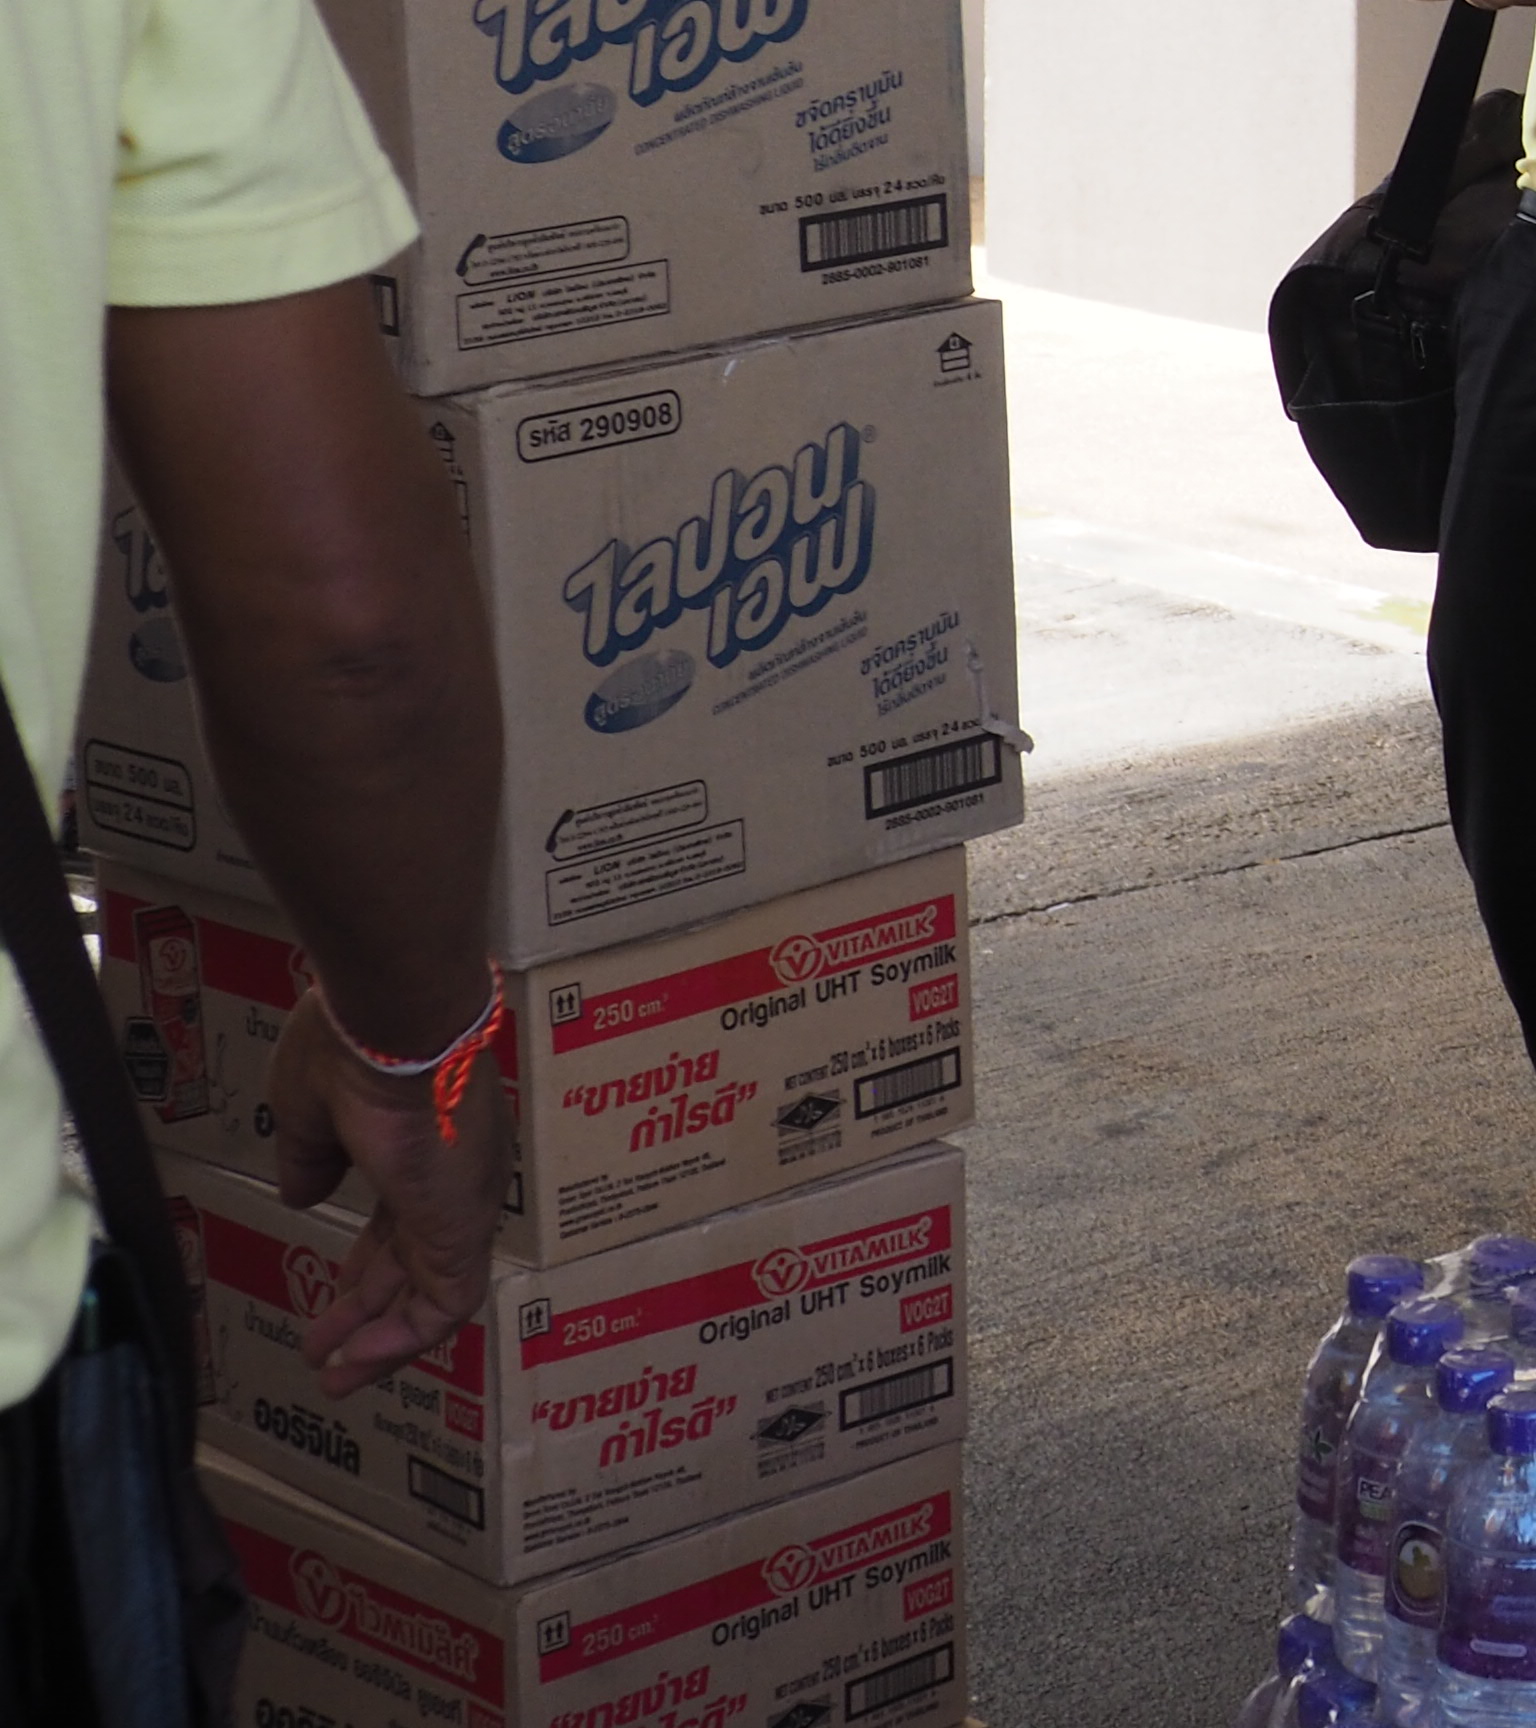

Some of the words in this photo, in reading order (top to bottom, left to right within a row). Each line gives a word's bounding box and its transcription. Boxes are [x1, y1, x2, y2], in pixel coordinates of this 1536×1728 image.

[795, 190, 824, 210] 500
[529, 421, 572, 449] รหัส
[580, 402, 673, 443] 290908
[563, 421, 860, 667] ไลปอน
[706, 479, 875, 670] เอฟ
[860, 739, 887, 758] 500
[826, 917, 934, 964] VITAMILK
[721, 990, 806, 1032] Original
[816, 972, 861, 1004] UHT
[871, 943, 957, 986] Soymilk
[593, 998, 634, 1032] 250
[814, 1227, 929, 1274] VITAMILK
[700, 1299, 791, 1344] Original
[800, 1280, 850, 1316] UHT
[860, 1254, 952, 1297] Soymilk
[562, 1316, 606, 1347] 250
[822, 1512, 931, 1566] VITAMILK
[711, 1601, 799, 1647] Original
[808, 1576, 855, 1611] UHT
[865, 1541, 952, 1590] Soymilk
[582, 1624, 624, 1658] 250
